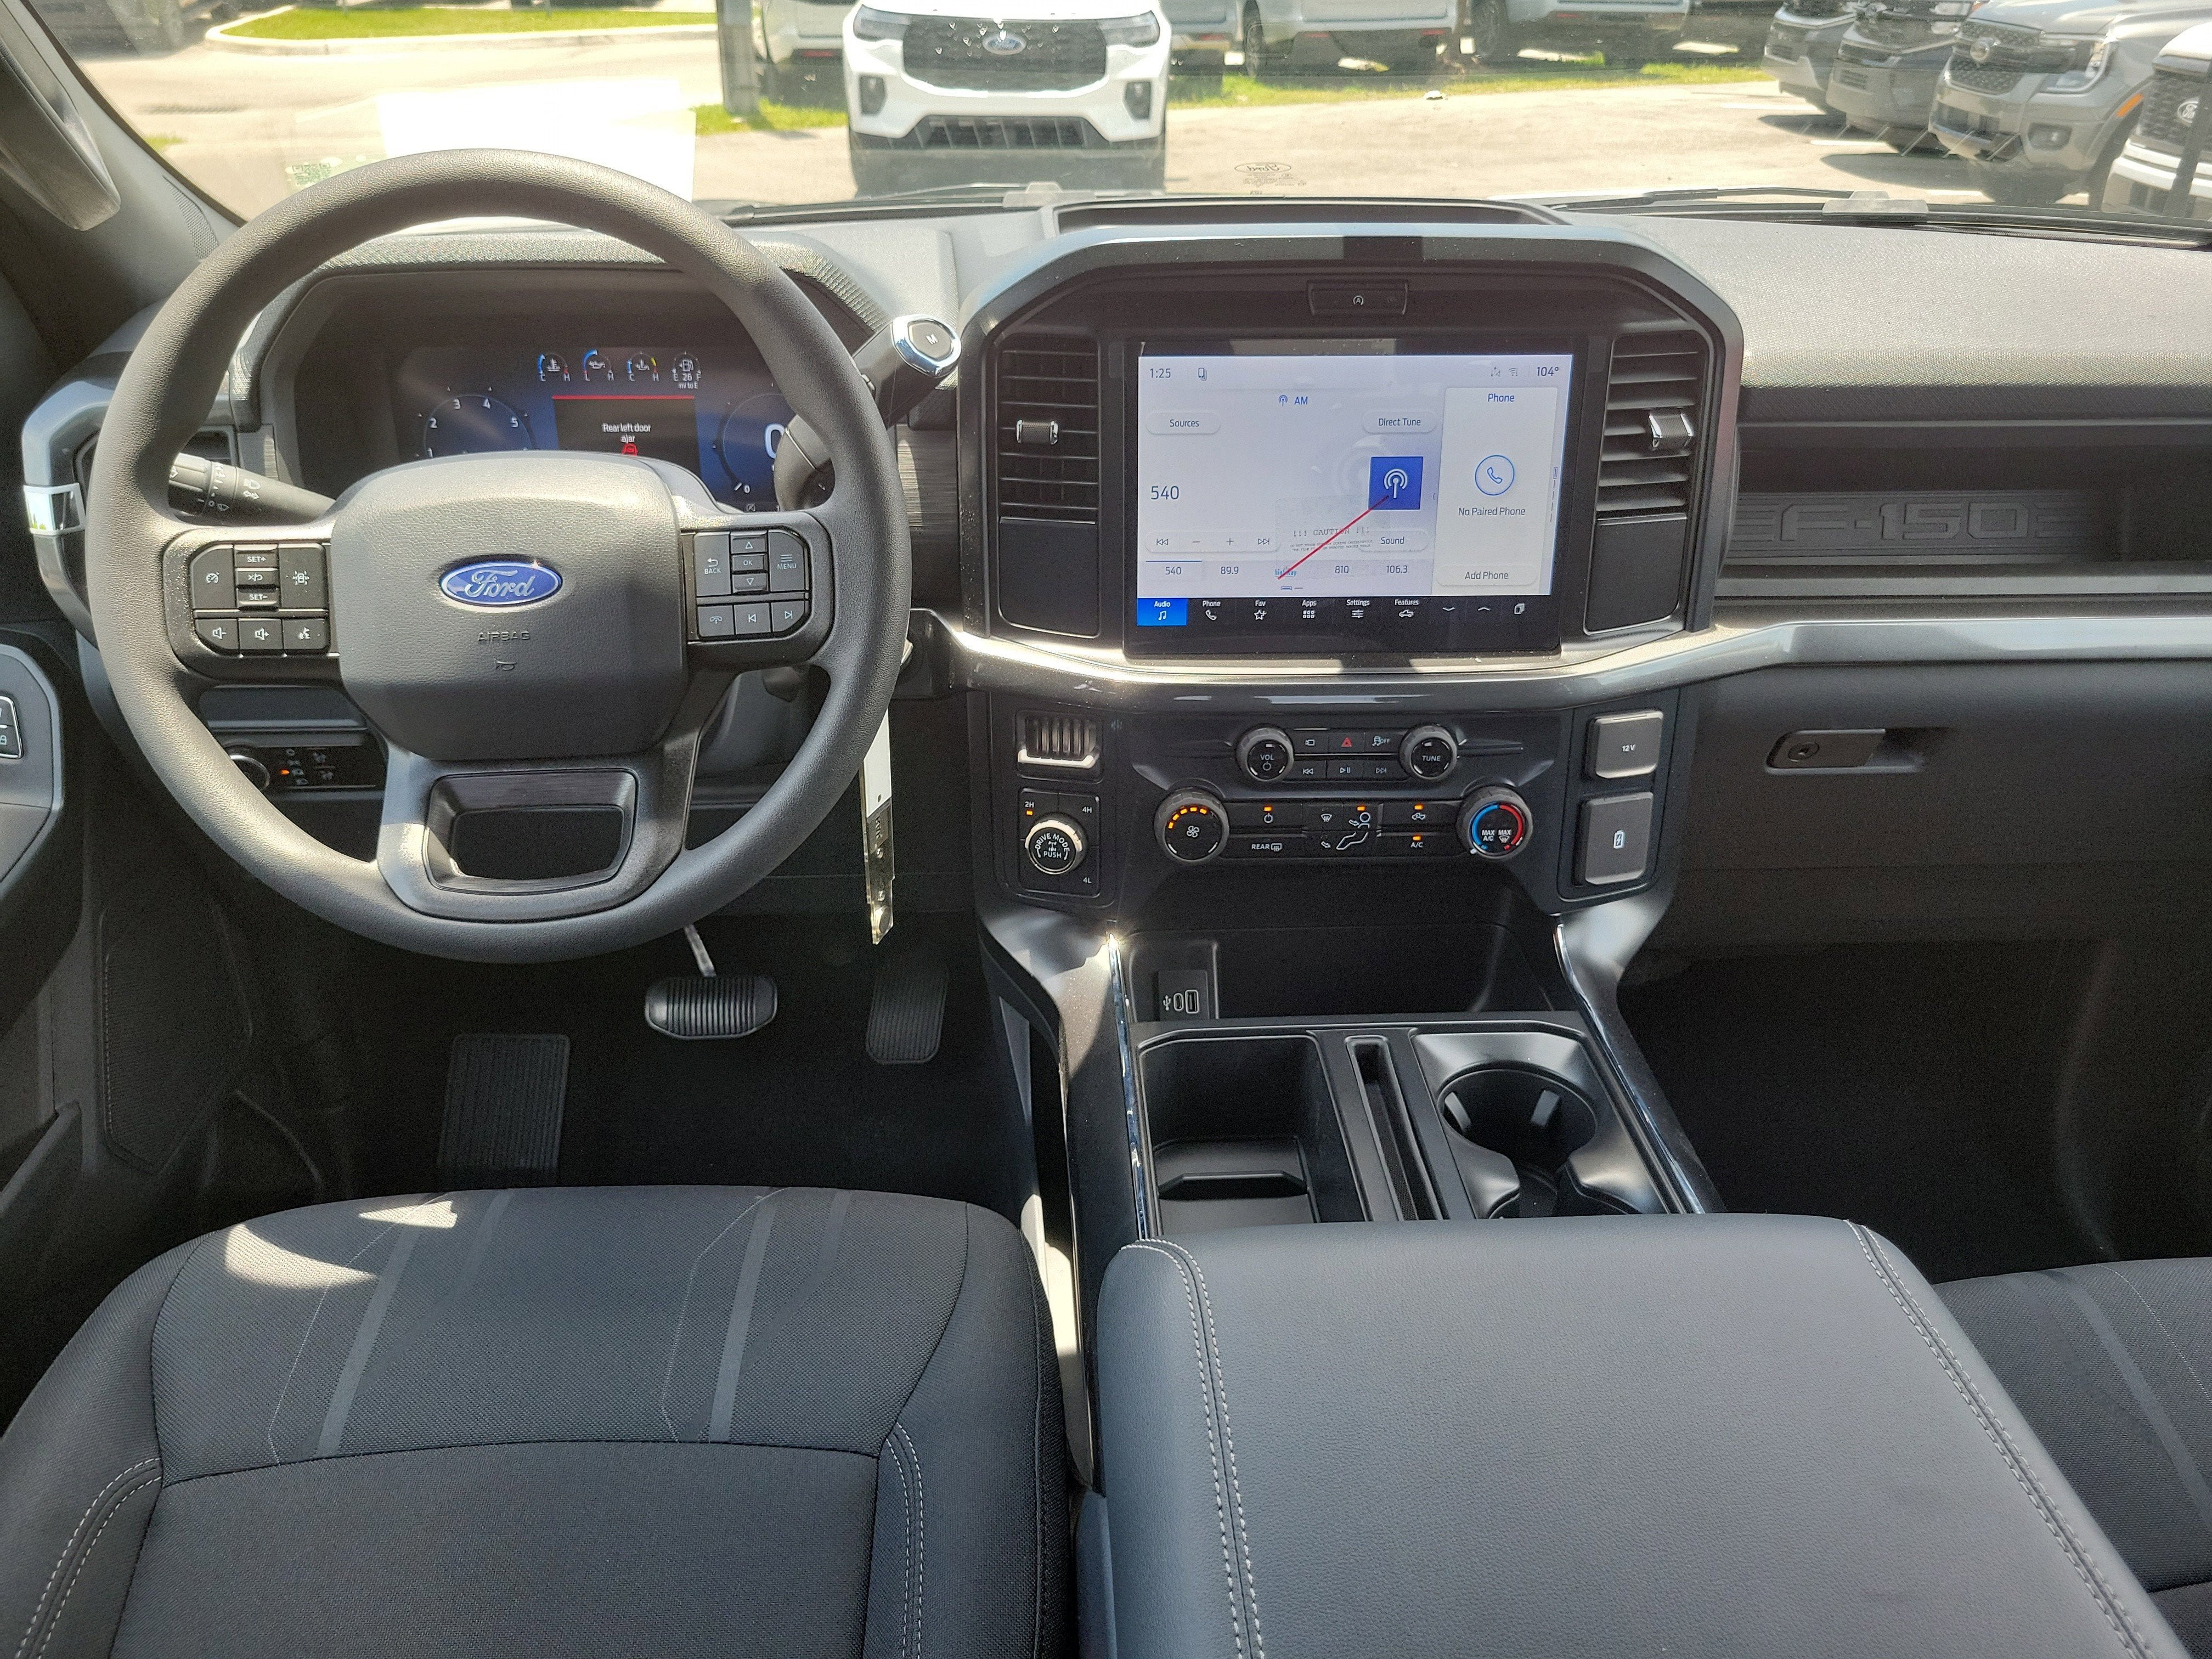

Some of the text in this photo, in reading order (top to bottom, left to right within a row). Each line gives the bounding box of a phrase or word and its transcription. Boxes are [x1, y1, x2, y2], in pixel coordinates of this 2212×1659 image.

[926, 334, 939, 345] M
[1150, 368, 1171, 378] 1:25
[1294, 396, 1308, 405] AM
[1487, 393, 1515, 402] Phone
[453, 398, 461, 409] 3
[482, 398, 491, 409] 4
[429, 417, 438, 428] 2
[511, 416, 519, 428] 5
[601, 422, 651, 432] Rear left door
[1170, 419, 1199, 427] Sources
[1378, 418, 1400, 426] Direct
[620, 433, 635, 444] ajar
[1151, 486, 1180, 500] 540
[1458, 507, 1526, 516] No Paired Phone
[1780, 501, 2029, 541] F-150
[1380, 537, 1404, 545] Sound
[1165, 567, 1182, 575] 540
[1220, 566, 1239, 574] 89.9
[1335, 566, 1349, 574] 810
[1386, 565, 1408, 573] 106.3
[1464, 571, 1509, 579] Add Phone
[464, 569, 535, 597] Ford
[476, 630, 531, 642] AIRBAG
[1035, 832, 1070, 852] DRIVE MODE
[1043, 850, 1062, 859] PUSH
